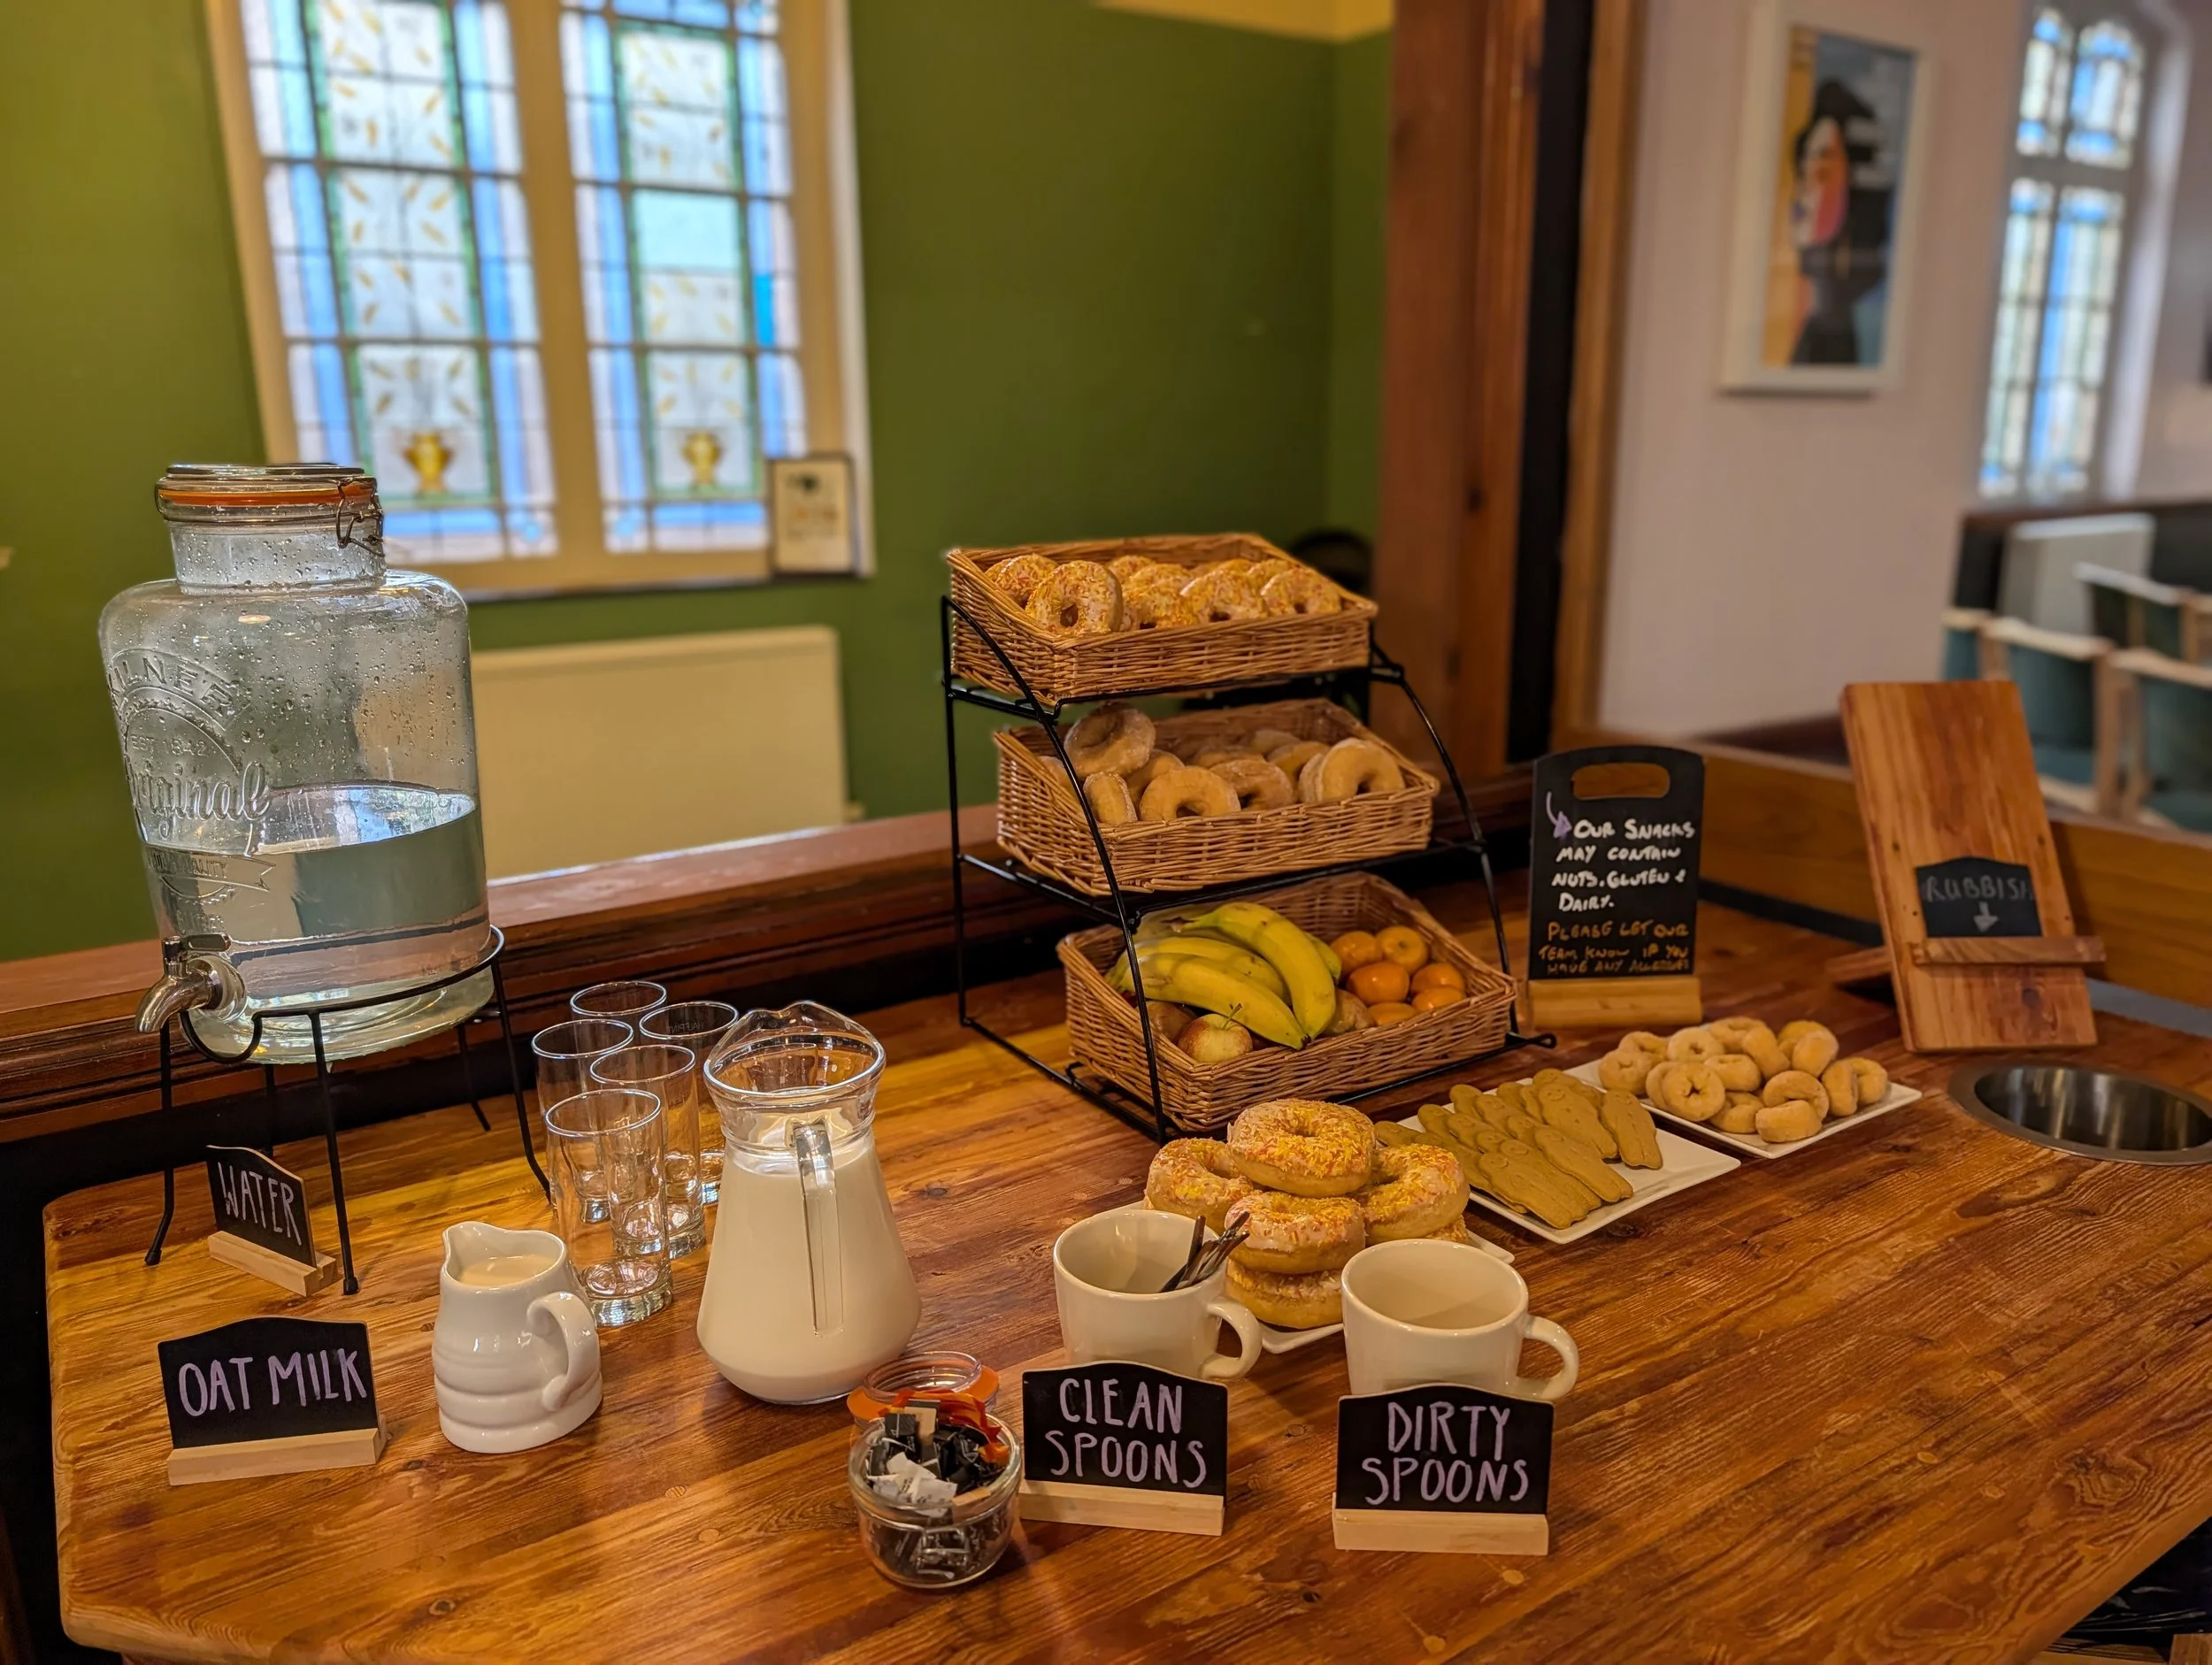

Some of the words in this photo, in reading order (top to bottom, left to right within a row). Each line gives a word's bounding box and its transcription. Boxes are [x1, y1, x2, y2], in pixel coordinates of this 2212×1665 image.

[1573, 818, 1616, 839] OUR
[1624, 817, 1695, 840] SNACKS
[1555, 845, 1596, 863] MAY
[1607, 845, 1681, 861] CONTAIN
[1606, 868, 1671, 889] GLUTEN
[1926, 875, 2033, 902] RUBBISH
[1548, 920, 1613, 941] PLEASE
[1619, 918, 1654, 937] LET
[1654, 923, 1689, 939] OUR
[1538, 944, 1578, 961] TEAM
[1585, 946, 1630, 960] KNOW
[1642, 942, 1659, 958] IF
[1666, 944, 1688, 959] YOU
[1594, 959, 1624, 972] ANY
[218, 1162, 302, 1246] WATER
[178, 1356, 254, 1417] OAT
[268, 1348, 367, 1407] MILK
[1059, 1377, 1182, 1434] CLEAN
[1387, 1400, 1510, 1462] DIRTY
[1044, 1430, 1207, 1489] SPOONS
[1362, 1457, 1529, 1505] SPOONS
